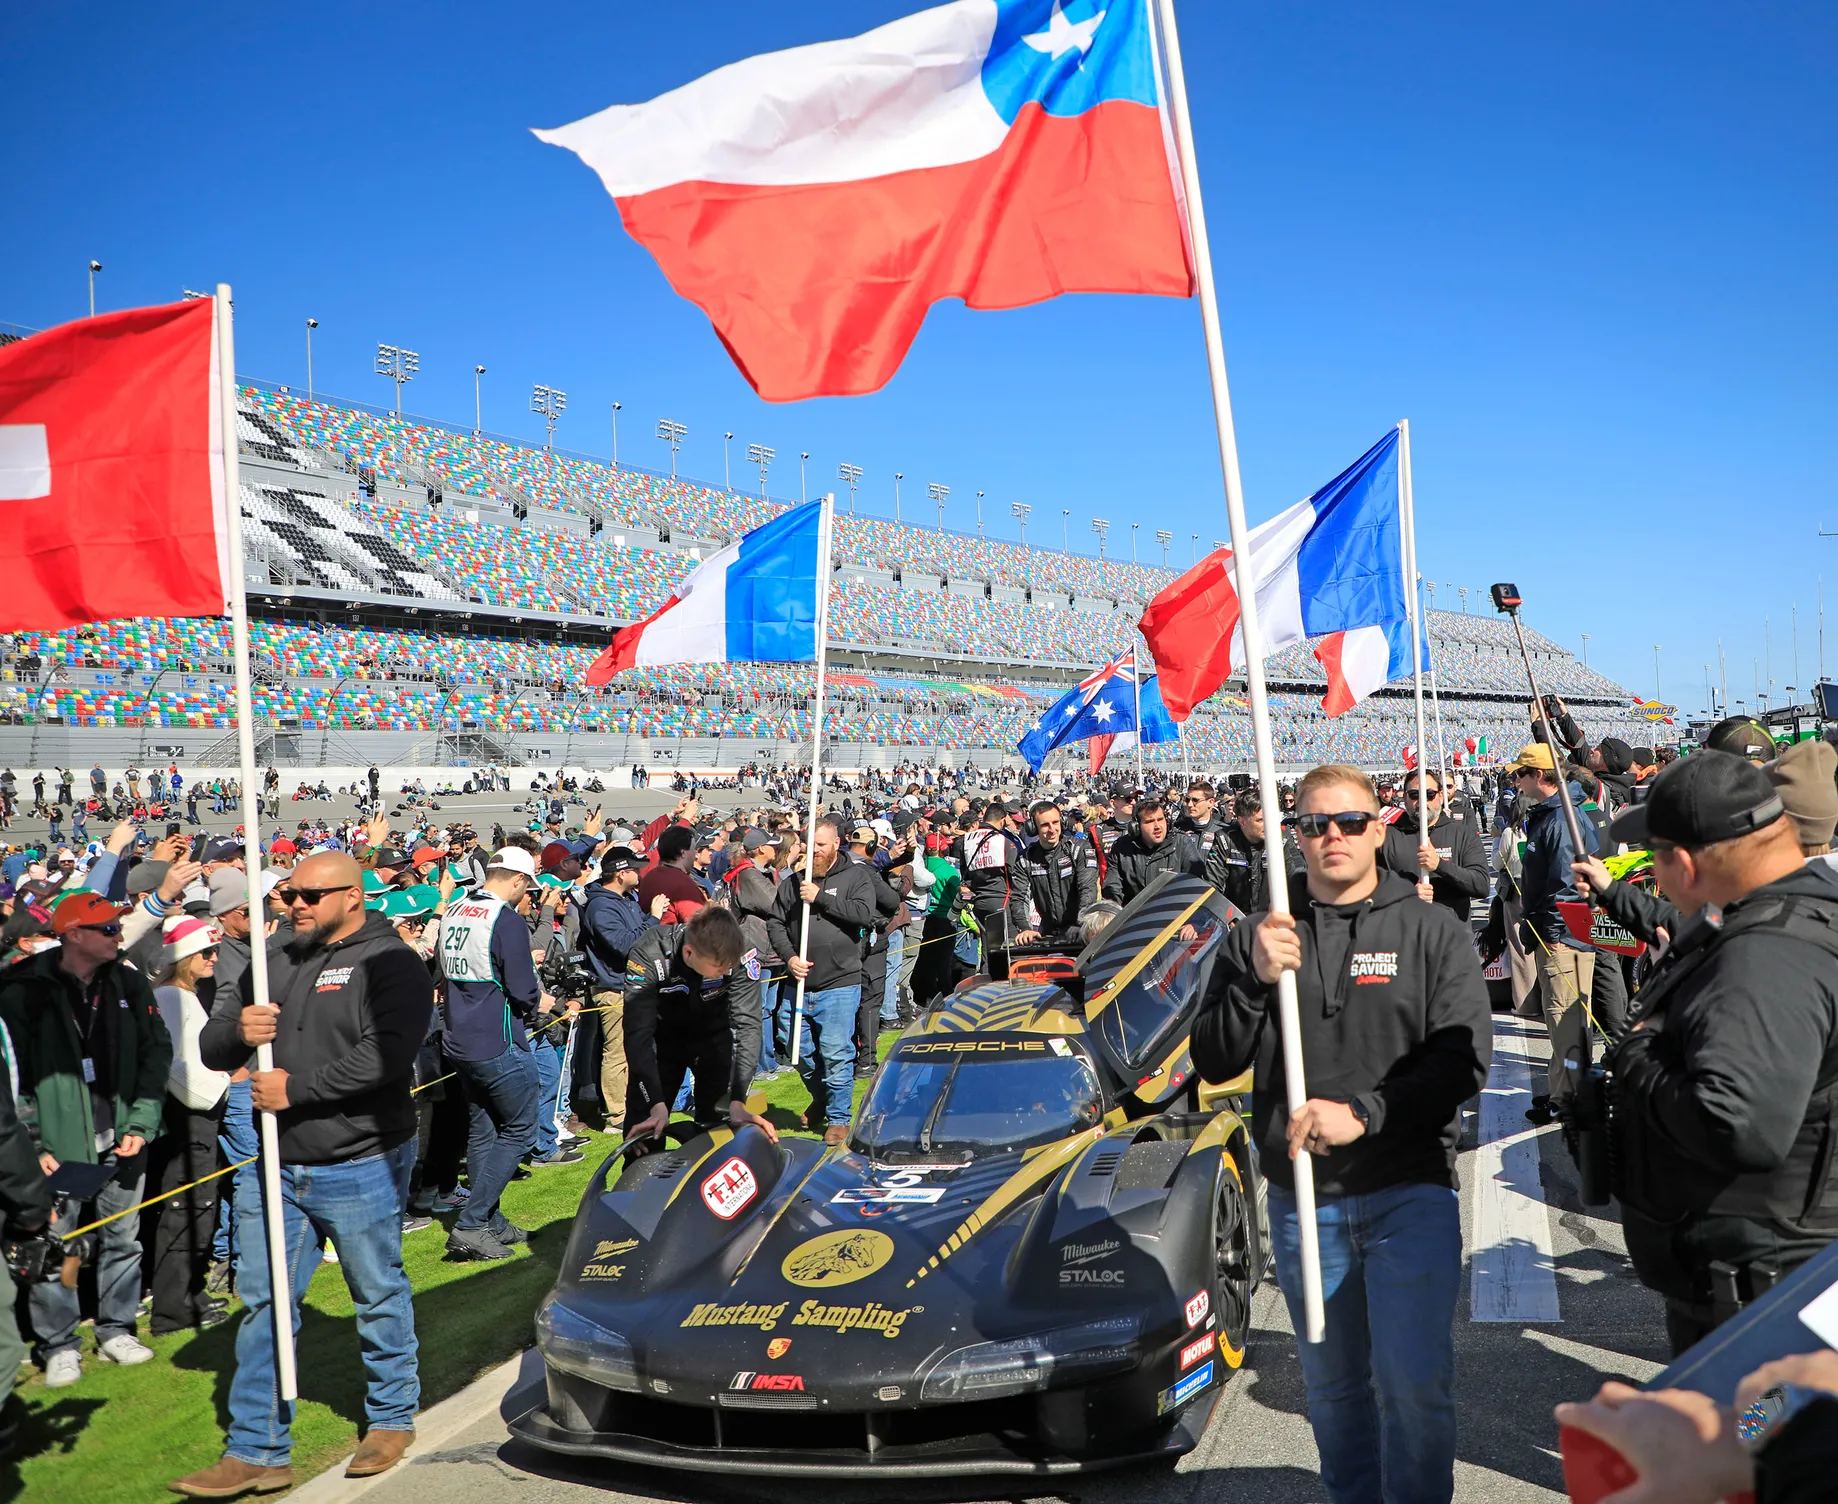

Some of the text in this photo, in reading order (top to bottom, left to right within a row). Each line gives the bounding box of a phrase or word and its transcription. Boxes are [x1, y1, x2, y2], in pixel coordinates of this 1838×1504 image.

[1634, 706, 1674, 716] SUNOCO
[458, 905, 489, 919] IMSA
[1593, 912, 1622, 927] VASS
[445, 926, 471, 951] 297
[1590, 926, 1635, 942] SULLIVAN
[1351, 952, 1398, 964] PROJECT
[1351, 963, 1398, 976] SAVIOR
[315, 974, 350, 987] SAVIOR
[899, 1041, 1046, 1054] PORSCHE
[881, 1169, 931, 1188] 5
[593, 1238, 639, 1256] Milwaukee
[1060, 1239, 1120, 1261] Milwaukee
[581, 1265, 626, 1277] STALOC
[1060, 1270, 1125, 1283] STALOC
[680, 1301, 790, 1331] Mustang
[1182, 1336, 1213, 1366] MOTUL
[752, 1374, 805, 1390] IMSA
[1175, 1371, 1209, 1399] MICHELIN
